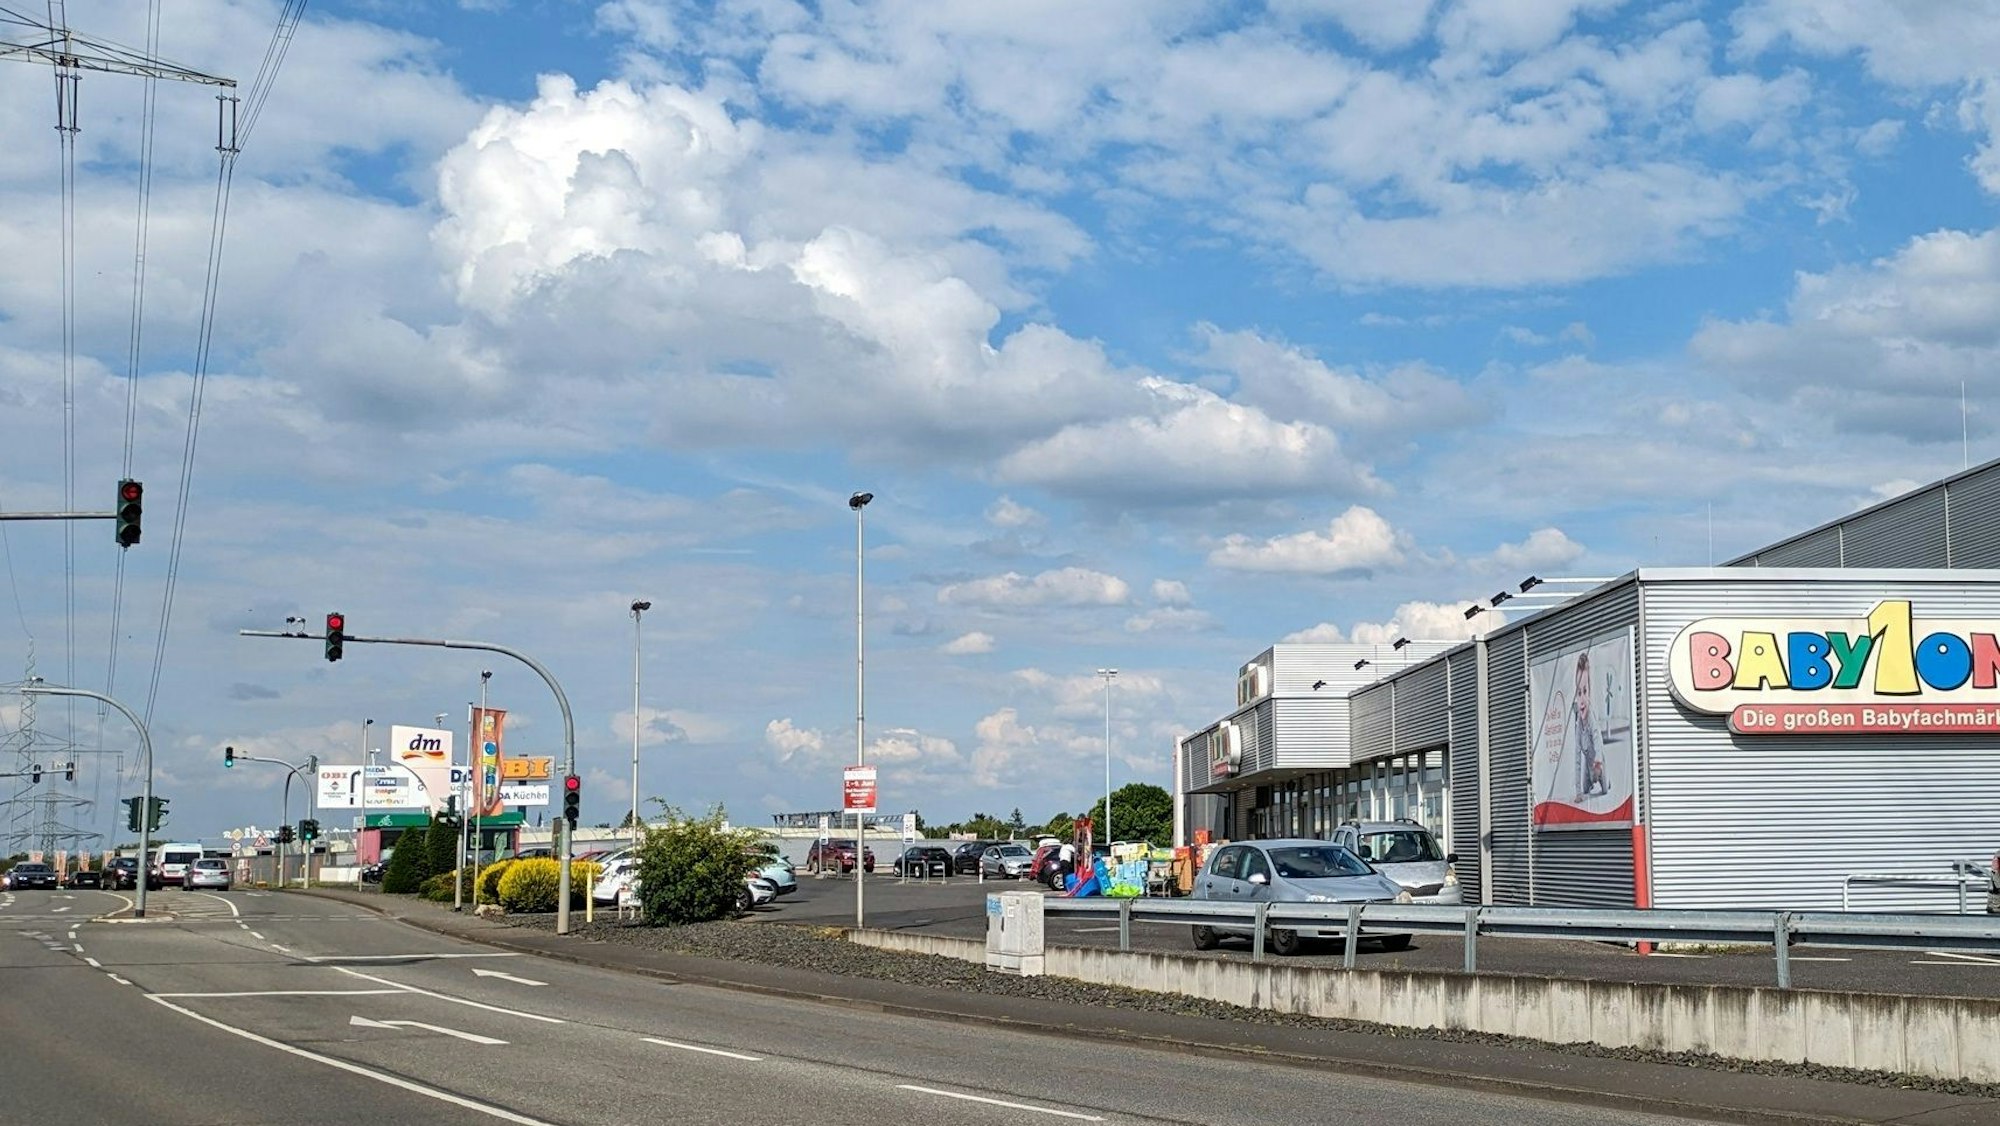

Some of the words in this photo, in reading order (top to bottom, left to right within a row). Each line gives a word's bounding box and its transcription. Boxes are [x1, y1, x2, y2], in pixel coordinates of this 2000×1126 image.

[1742, 709, 1776, 727] Die
[1783, 709, 1855, 730] großen
[409, 734, 441, 750] dm
[503, 759, 549, 778] BI
[513, 790, 548, 800] Küchen
